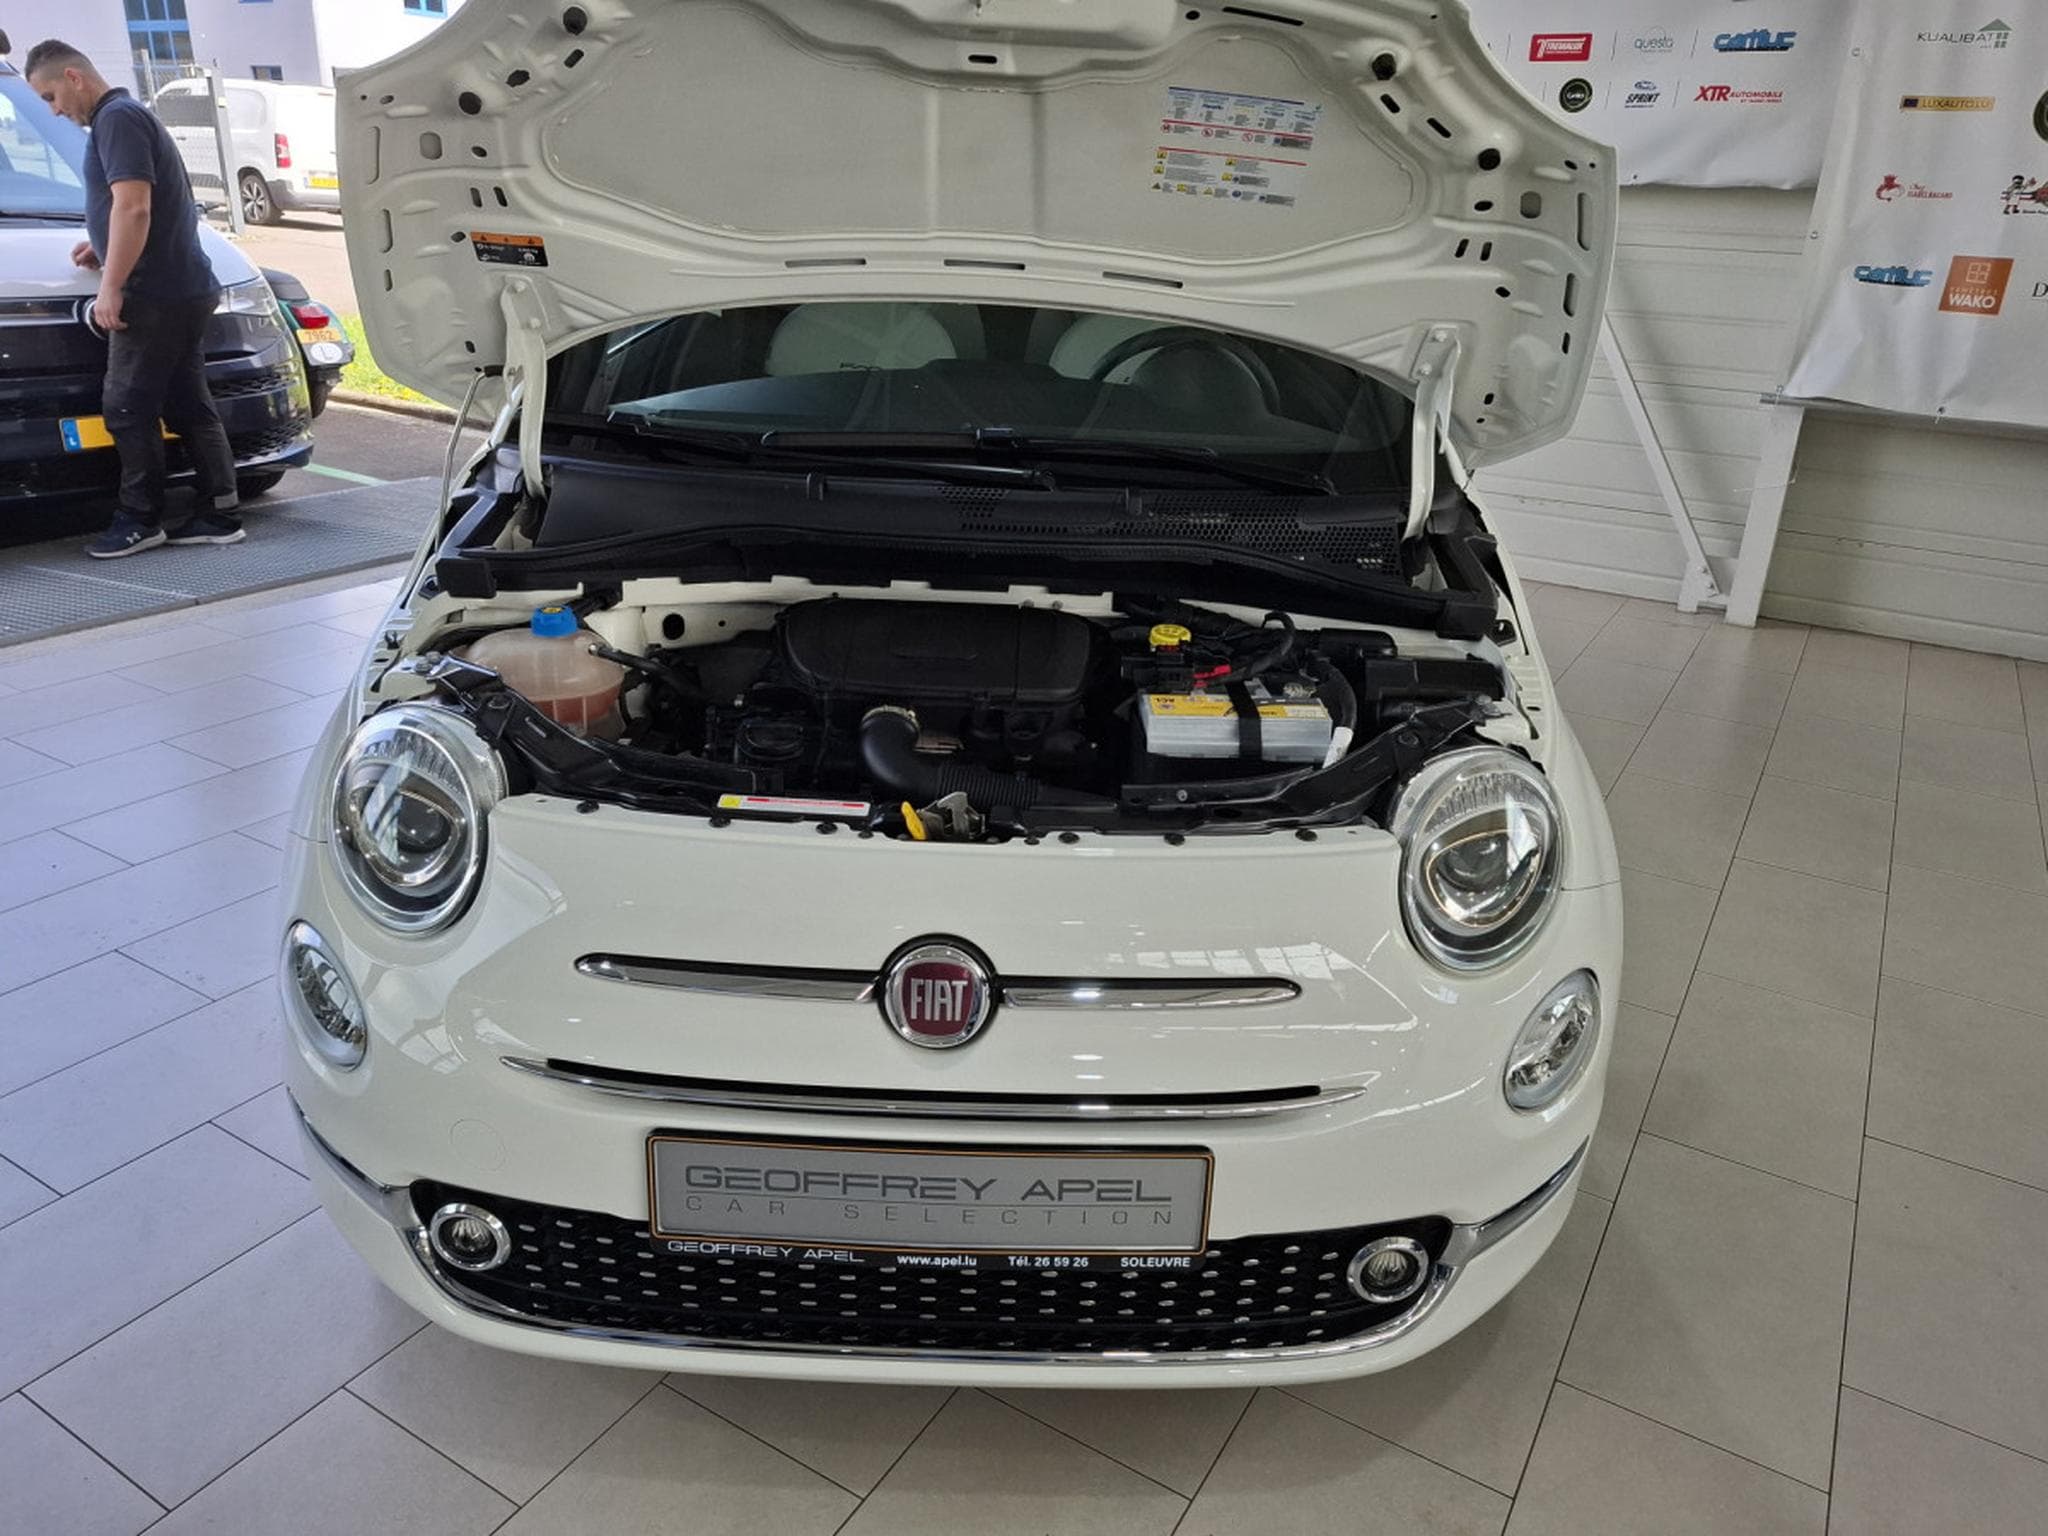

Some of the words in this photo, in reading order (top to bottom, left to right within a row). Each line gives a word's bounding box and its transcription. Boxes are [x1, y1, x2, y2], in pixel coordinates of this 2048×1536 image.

[1625, 92, 1660, 104] SPRINT
[1694, 85, 1731, 101] XTR
[1949, 293, 1996, 309] WAKO
[910, 977, 968, 1022] FIAT
[685, 1164, 998, 1201] GEOFFREY
[1021, 1178, 1172, 1202] APEL
[685, 1195, 786, 1217] CAR
[843, 1203, 1173, 1226] SELECTION
[667, 1240, 793, 1258] GEOFFREY
[803, 1248, 866, 1263] APEL
[896, 1254, 977, 1268] www.apel.lu
[1008, 1255, 1031, 1268] Tél.
[1034, 1257, 1050, 1267] 26
[1053, 1257, 1069, 1267] 59
[1072, 1257, 1089, 1267] 26
[1120, 1257, 1191, 1268] SOLEUVRE
